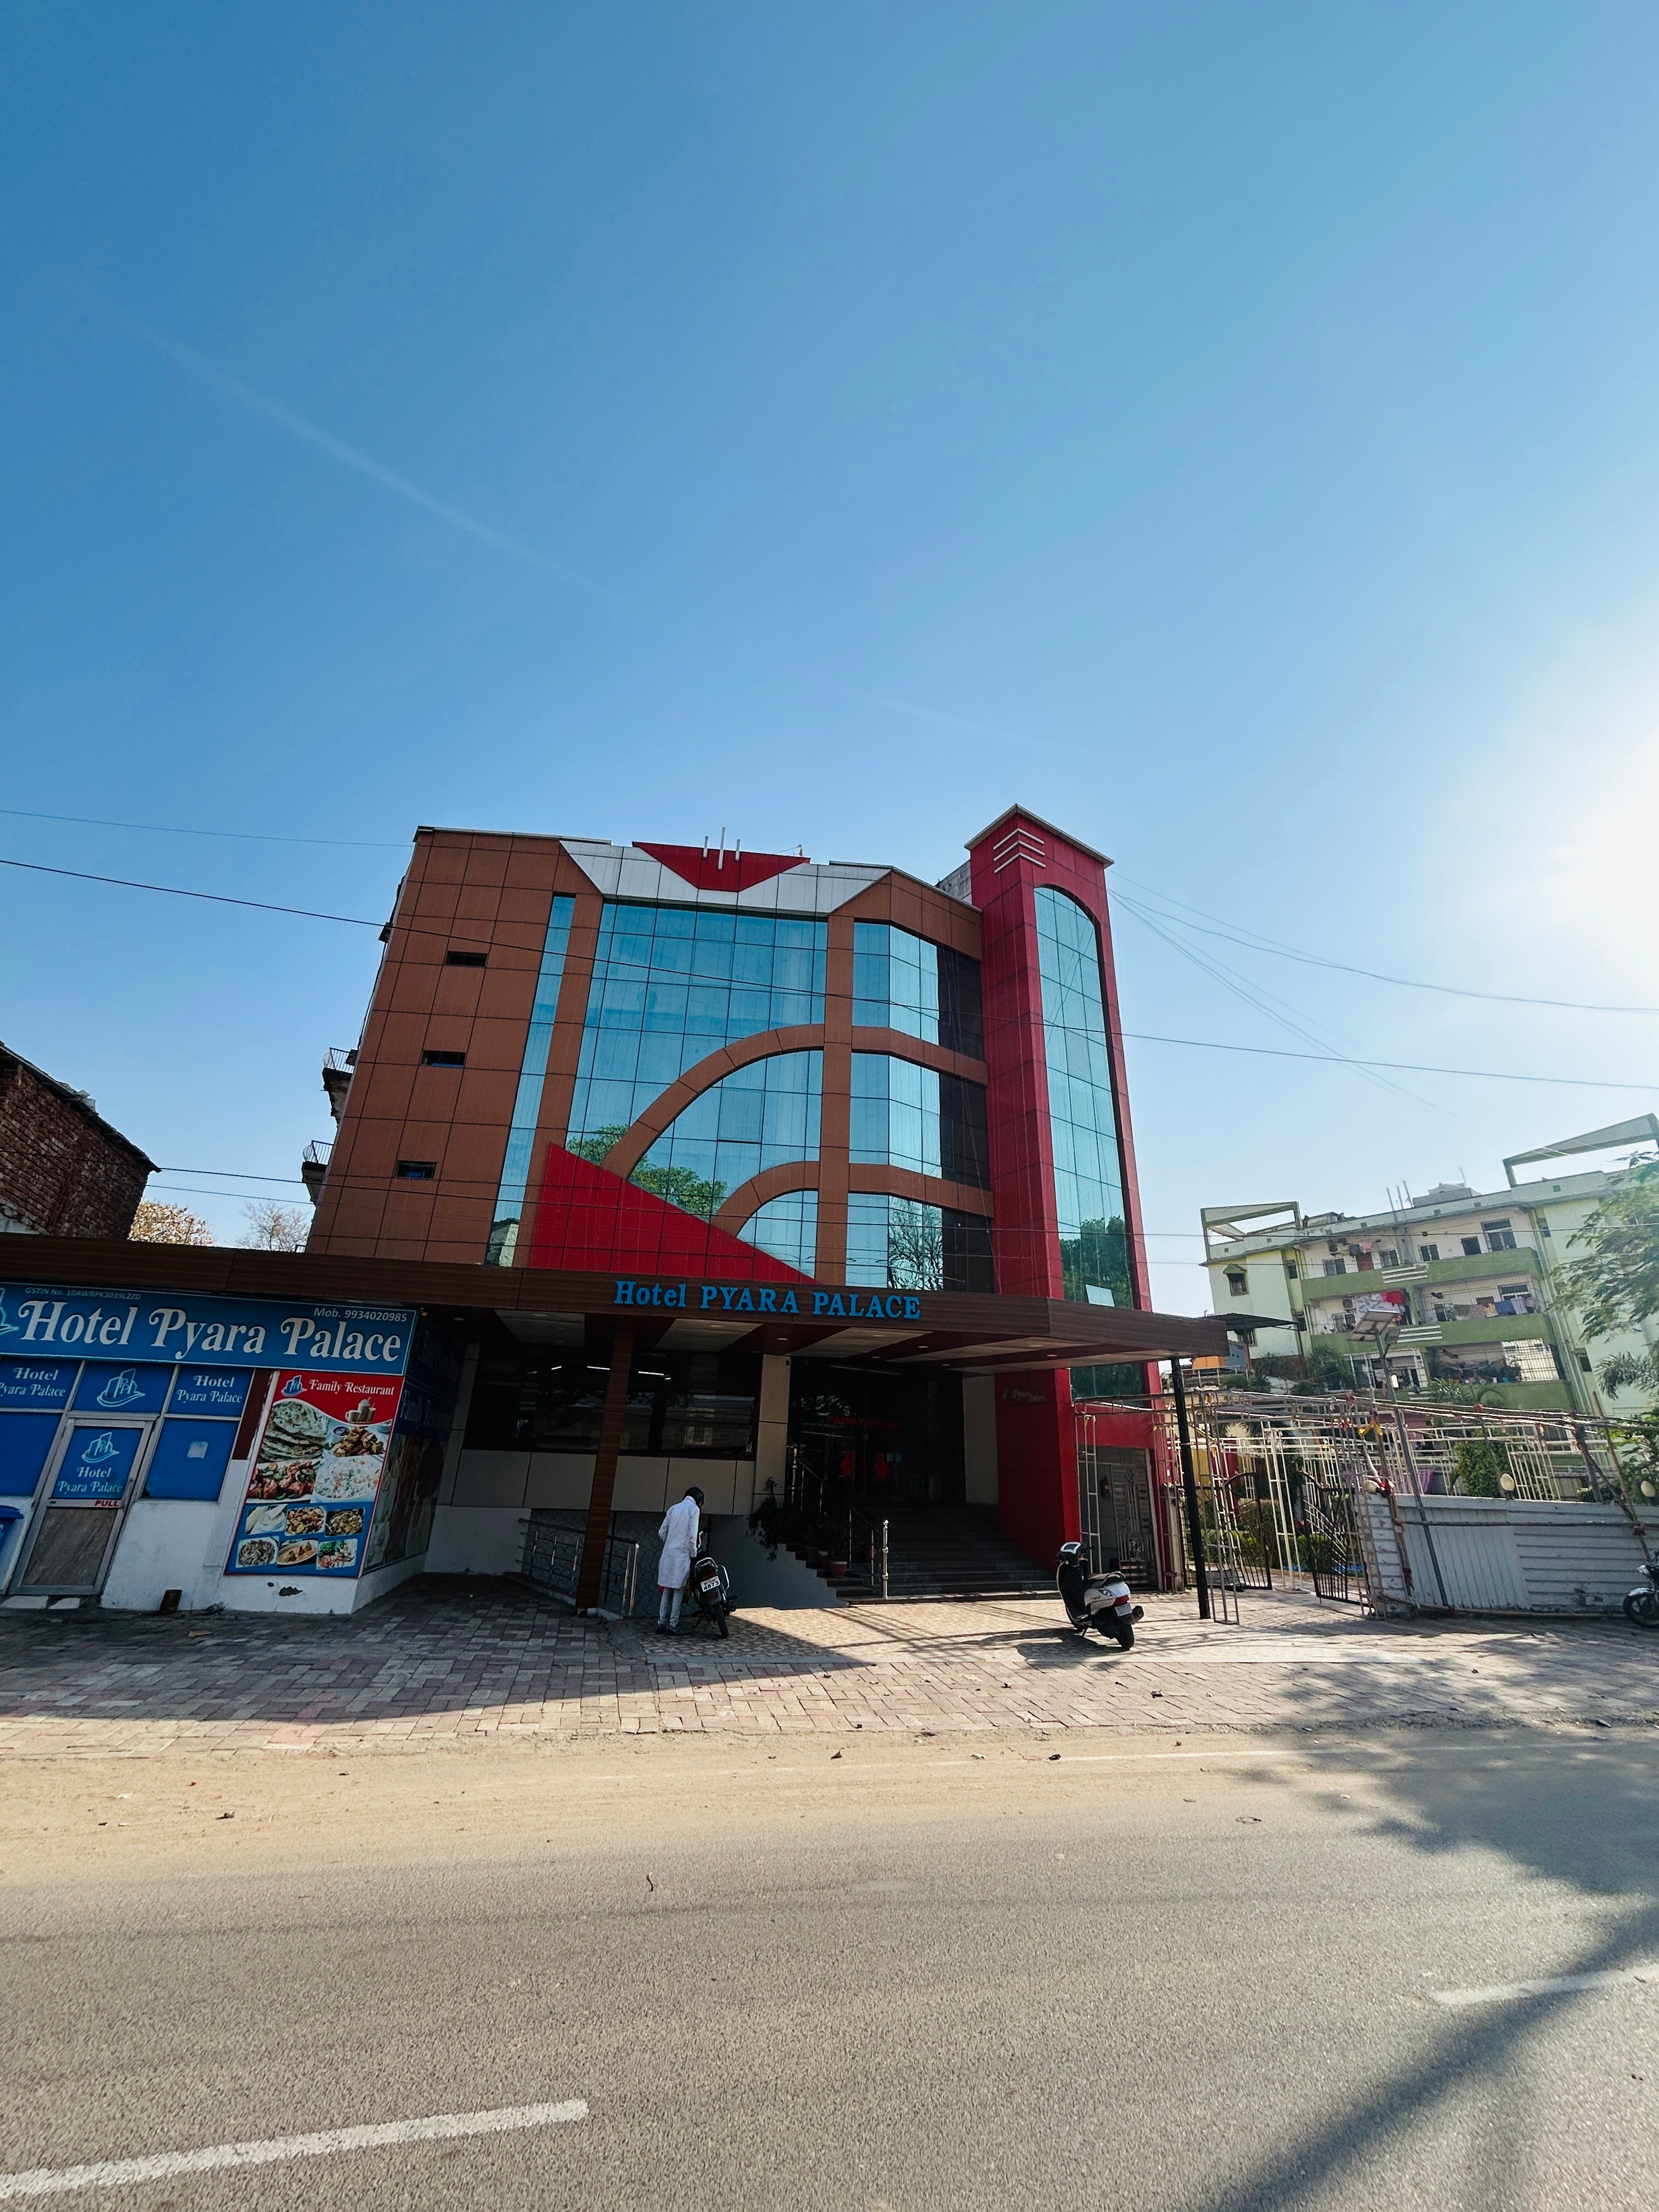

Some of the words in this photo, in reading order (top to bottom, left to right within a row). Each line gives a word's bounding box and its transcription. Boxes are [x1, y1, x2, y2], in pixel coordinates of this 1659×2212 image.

[614, 1280, 686, 1308] Hotel
[700, 1285, 799, 1313] PYARA
[812, 1290, 921, 1319] PALACE
[314, 1307, 341, 1317] Mob.
[345, 1310, 408, 1322] 9934020985
[18, 1300, 138, 1345] Hotel
[149, 1308, 266, 1359] Pyara
[280, 1317, 400, 1362] Palace
[13, 1367, 59, 1380] Hotel
[193, 1375, 235, 1387] Hotel
[309, 1379, 342, 1394] Family
[345, 1382, 395, 1396] Restaurant
[30, 1384, 66, 1397] Palace
[177, 1389, 206, 1403] Pyara
[210, 1391, 242, 1403] Palace
[76, 1466, 111, 1477] Hotel
[58, 1481, 87, 1494] Pyara
[91, 1481, 122, 1492] Palace
